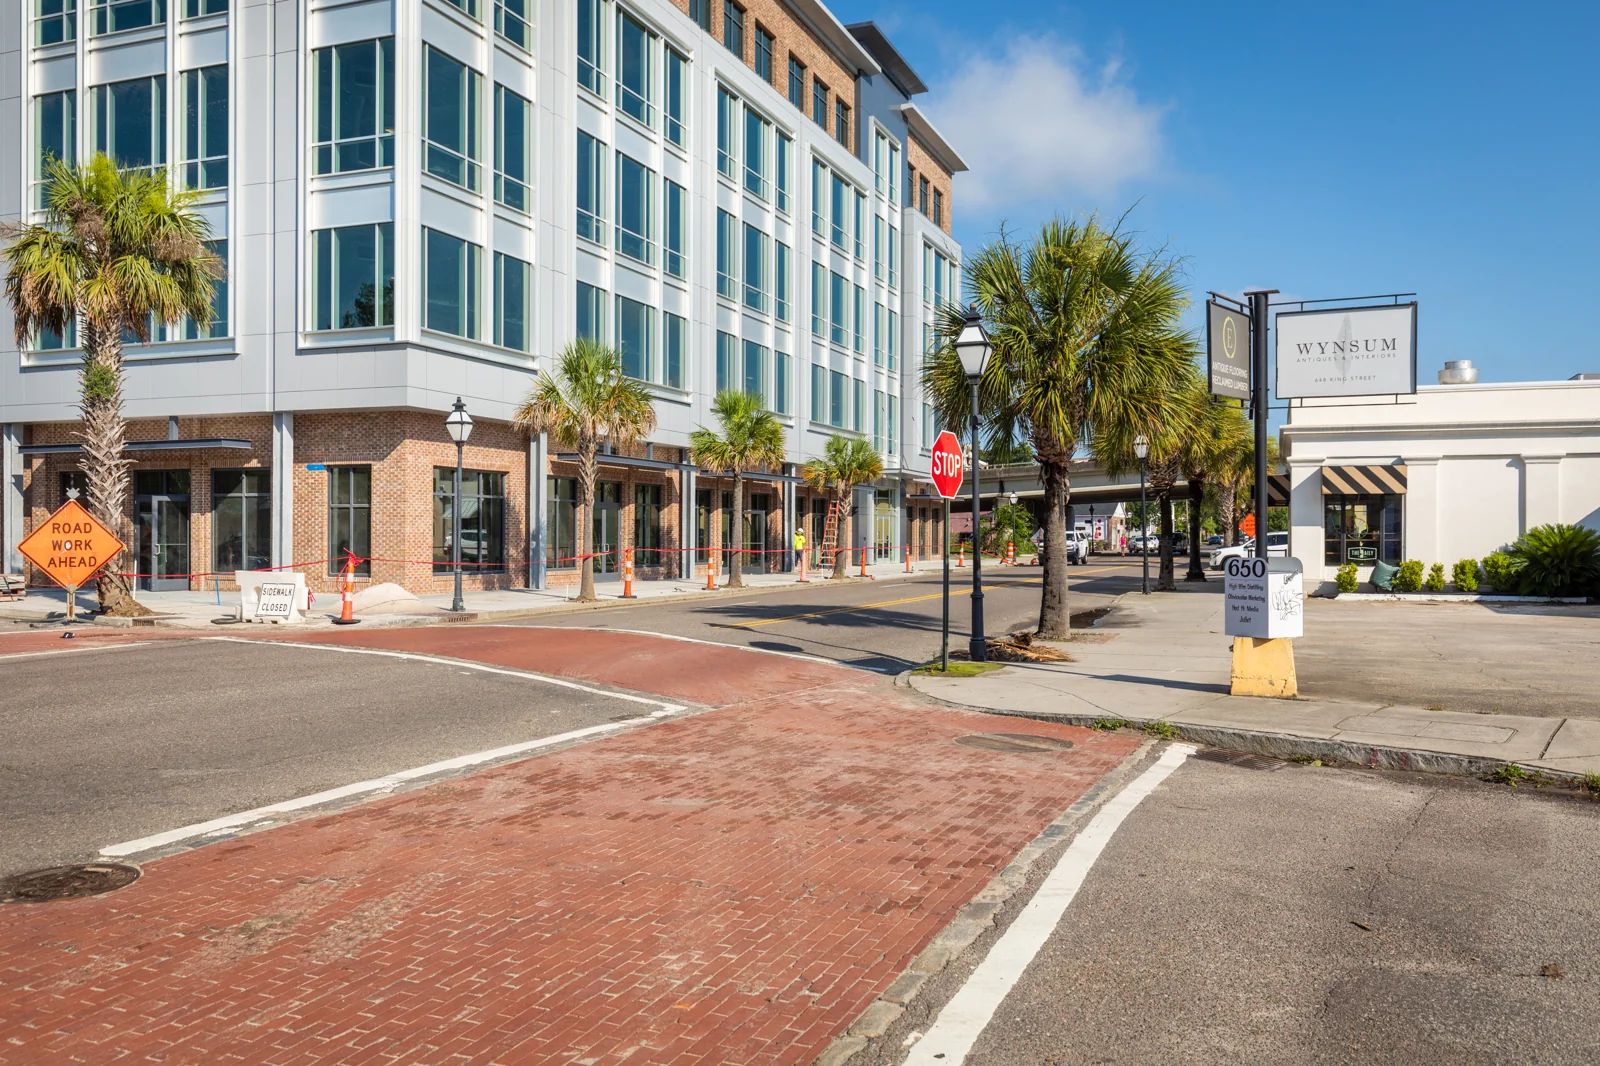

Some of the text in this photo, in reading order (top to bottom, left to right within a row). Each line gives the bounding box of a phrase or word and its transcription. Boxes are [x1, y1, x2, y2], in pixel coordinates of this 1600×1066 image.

[1296, 338, 1396, 355] WYNSUM
[1212, 361, 1248, 379] ANTIQUE FLOORING
[1212, 375, 1249, 392] RECLAIMED LUMBER
[933, 451, 961, 478] STOP
[52, 523, 92, 534] ROAD
[52, 540, 92, 551] WORK
[47, 556, 97, 568] AHEAD
[1228, 559, 1266, 578] 650
[262, 587, 292, 596] SIDEWALK
[1228, 583, 1237, 591] High
[261, 603, 288, 612] CLOSED
